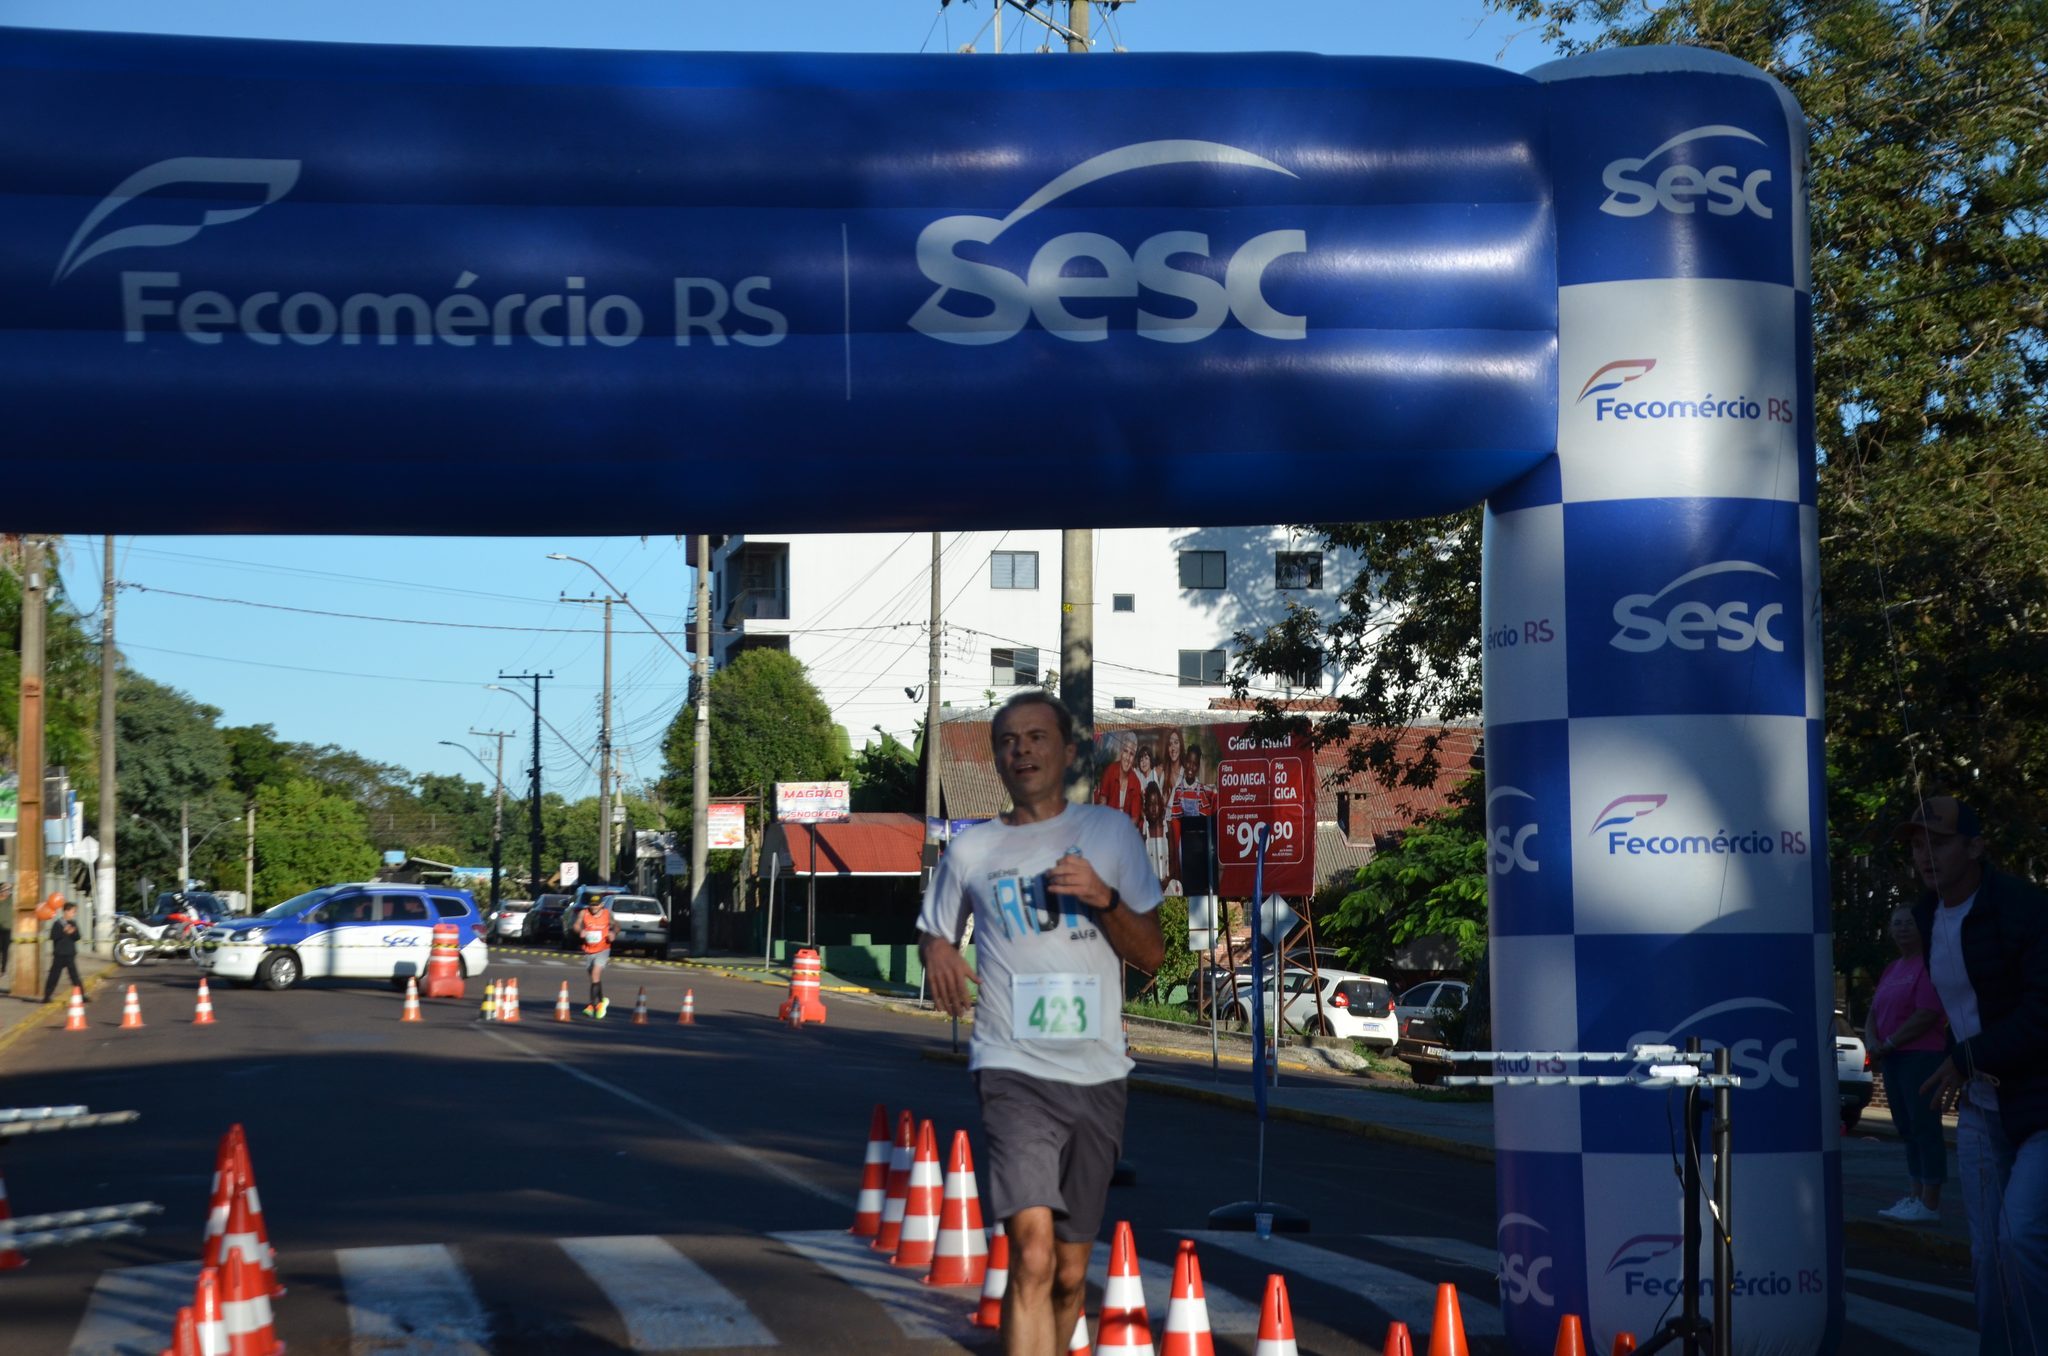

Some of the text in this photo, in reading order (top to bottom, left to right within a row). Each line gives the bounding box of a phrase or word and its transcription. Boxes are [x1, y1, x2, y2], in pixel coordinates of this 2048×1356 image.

[1599, 158, 1773, 220] Sesc
[907, 215, 1308, 346] Sesc
[120, 270, 789, 347] Fecomércio RS
[1596, 393, 1793, 424] Fecomércio RS
[1524, 618, 1555, 644] RS
[1608, 594, 1784, 652] Sesc
[1221, 772, 1266, 787] 600 MEGA
[1274, 771, 1288, 785] 60
[1274, 787, 1297, 800] GIGA
[1226, 823, 1235, 836] R$
[1609, 830, 1806, 855] Fecomércio RS
[1028, 995, 1088, 1034] 423
[1624, 1030, 1799, 1090] Ssc
[1625, 1270, 1823, 1297] Fecmércio RS
